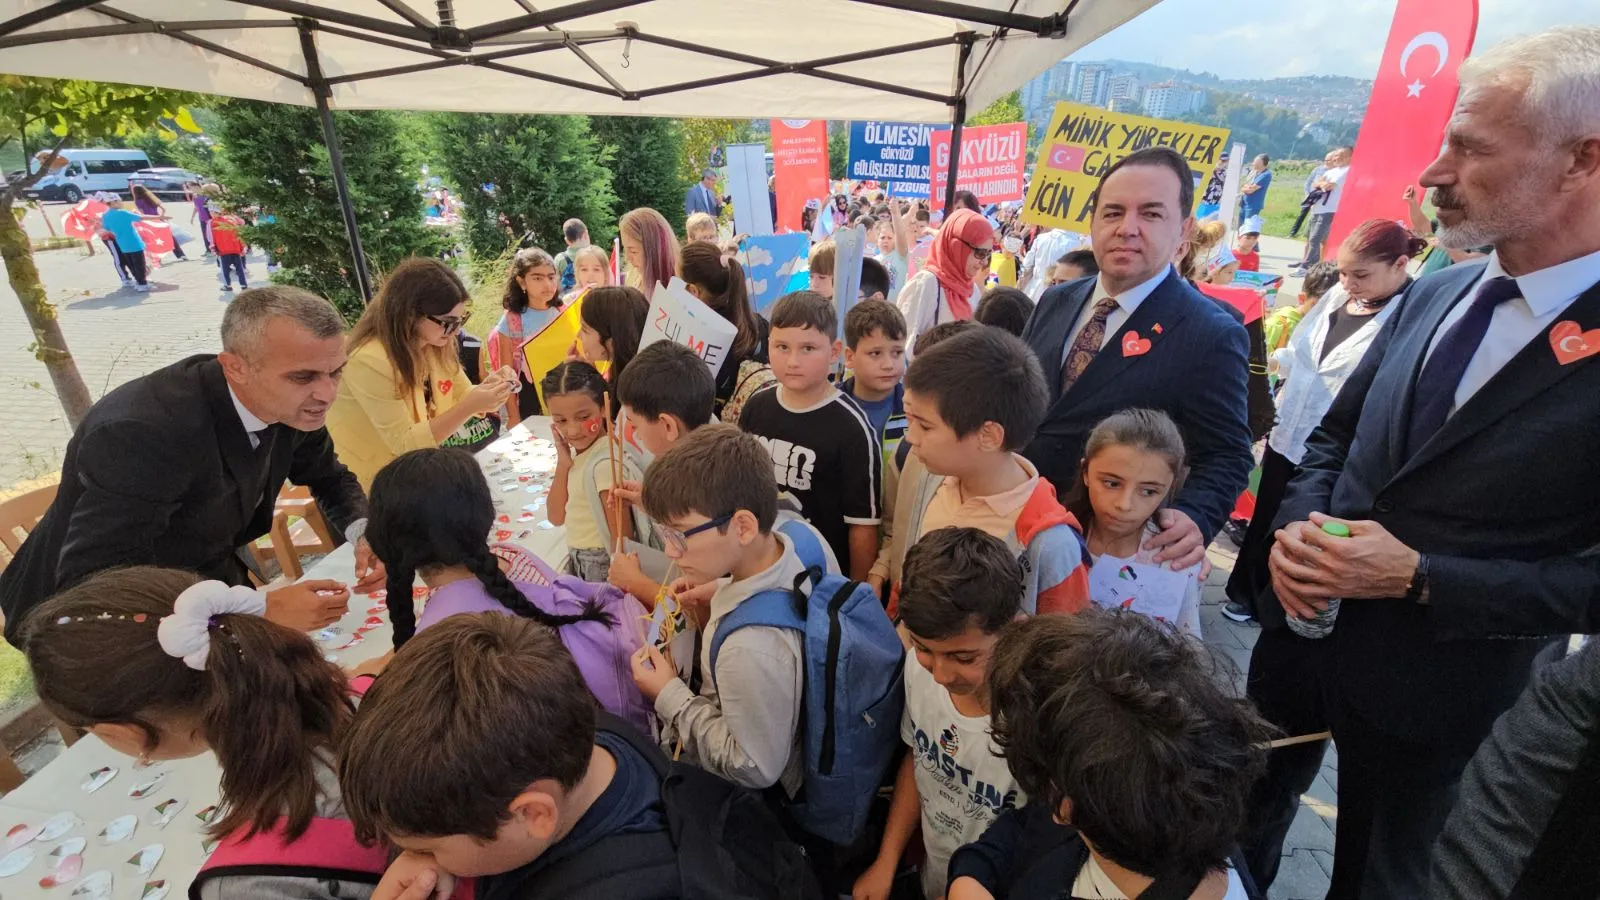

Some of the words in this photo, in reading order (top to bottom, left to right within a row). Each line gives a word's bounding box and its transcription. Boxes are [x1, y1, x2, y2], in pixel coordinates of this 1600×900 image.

[1053, 112, 1116, 148] MİNİK
[880, 147, 914, 161] GÖKYÜZÜ
[936, 130, 1020, 168] GKYÜZÜ
[853, 160, 904, 179] GÜLÜŞLERLE
[936, 168, 993, 182] BOBALARIN
[1030, 175, 1075, 220] İÇİN
